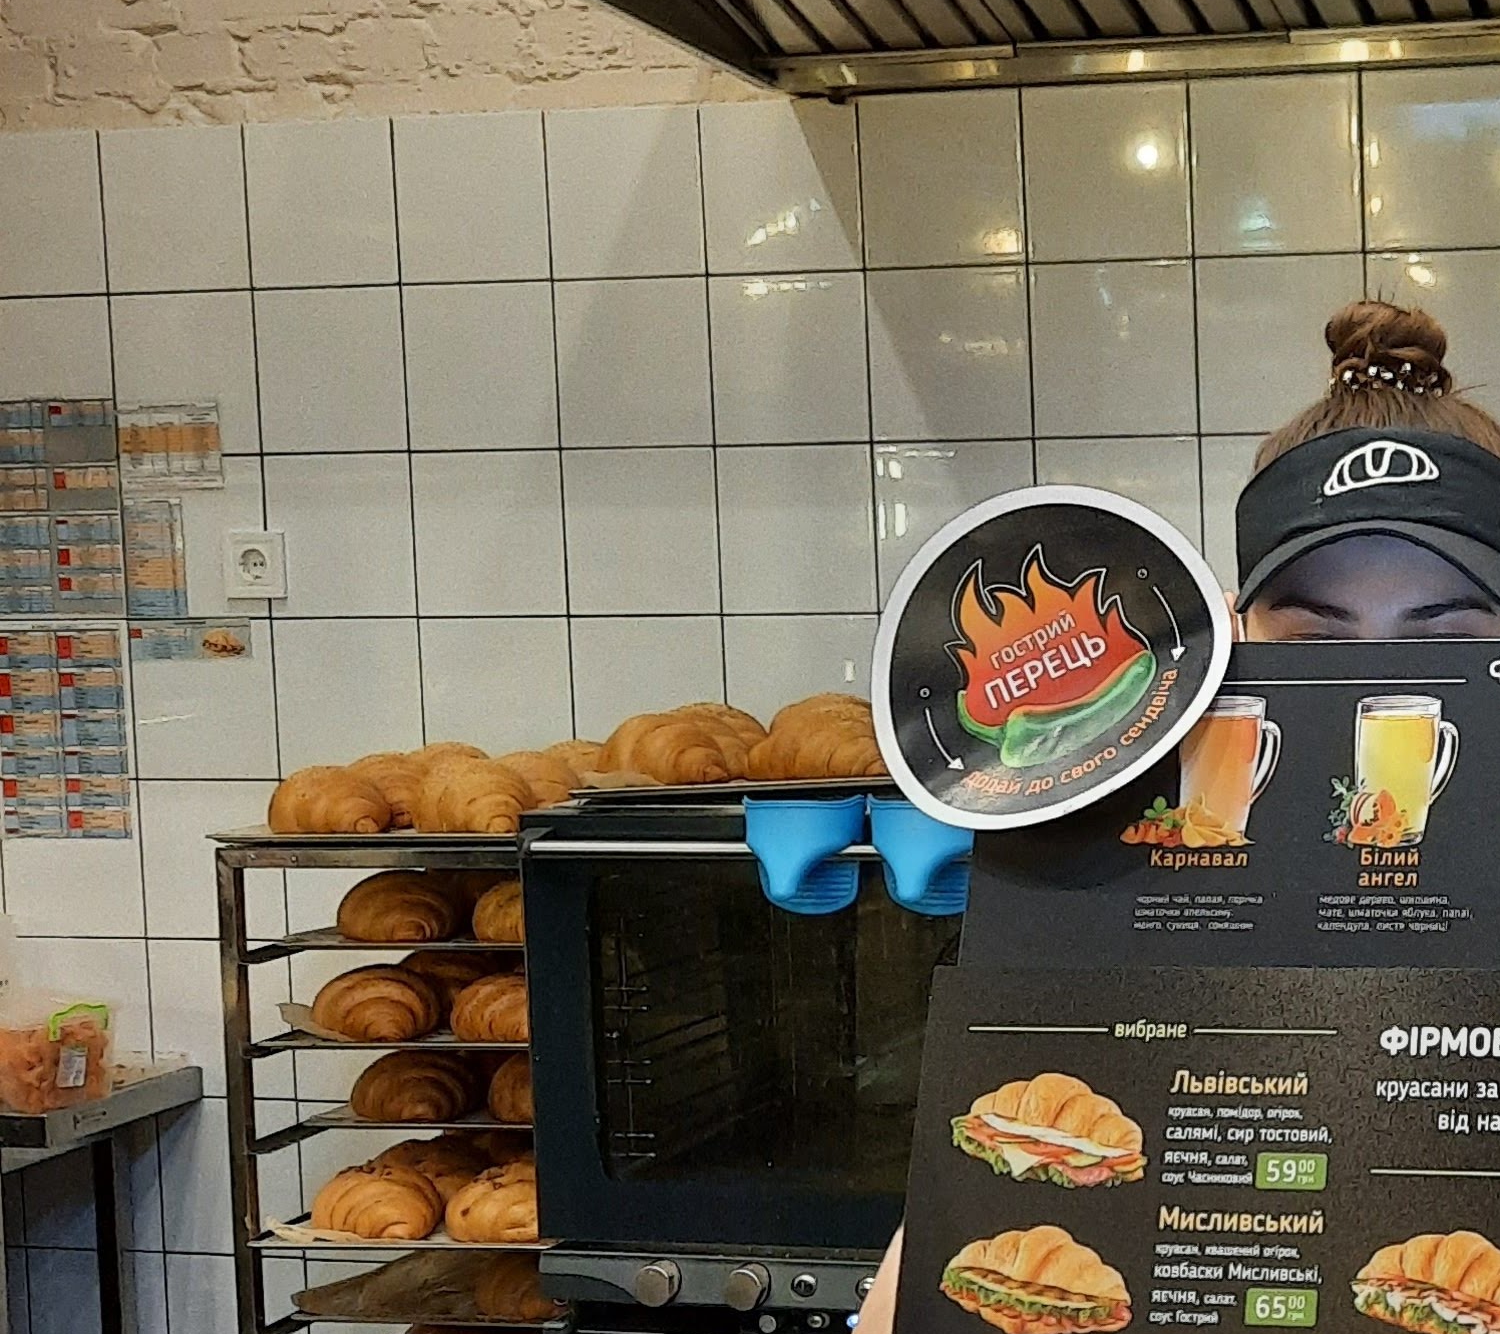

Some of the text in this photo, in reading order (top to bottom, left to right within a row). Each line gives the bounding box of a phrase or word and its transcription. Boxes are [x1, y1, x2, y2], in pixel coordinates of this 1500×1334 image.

[990, 609, 1075, 669] гострий
[984, 633, 1106, 708] ПЕРЕЦЬ
[961, 669, 1178, 796] додай до свого сендвіча
[1150, 849, 1248, 871] Карнавал
[1360, 847, 1419, 866] Білий
[1358, 872, 1418, 887] ангел
[1114, 1018, 1188, 1043] вибране
[1170, 1069, 1308, 1095] Львівський
[1376, 1080, 1469, 1102] круасани
[1476, 1081, 1499, 1099] за
[1438, 1109, 1470, 1134] від
[1158, 1205, 1324, 1234] Мисливський
